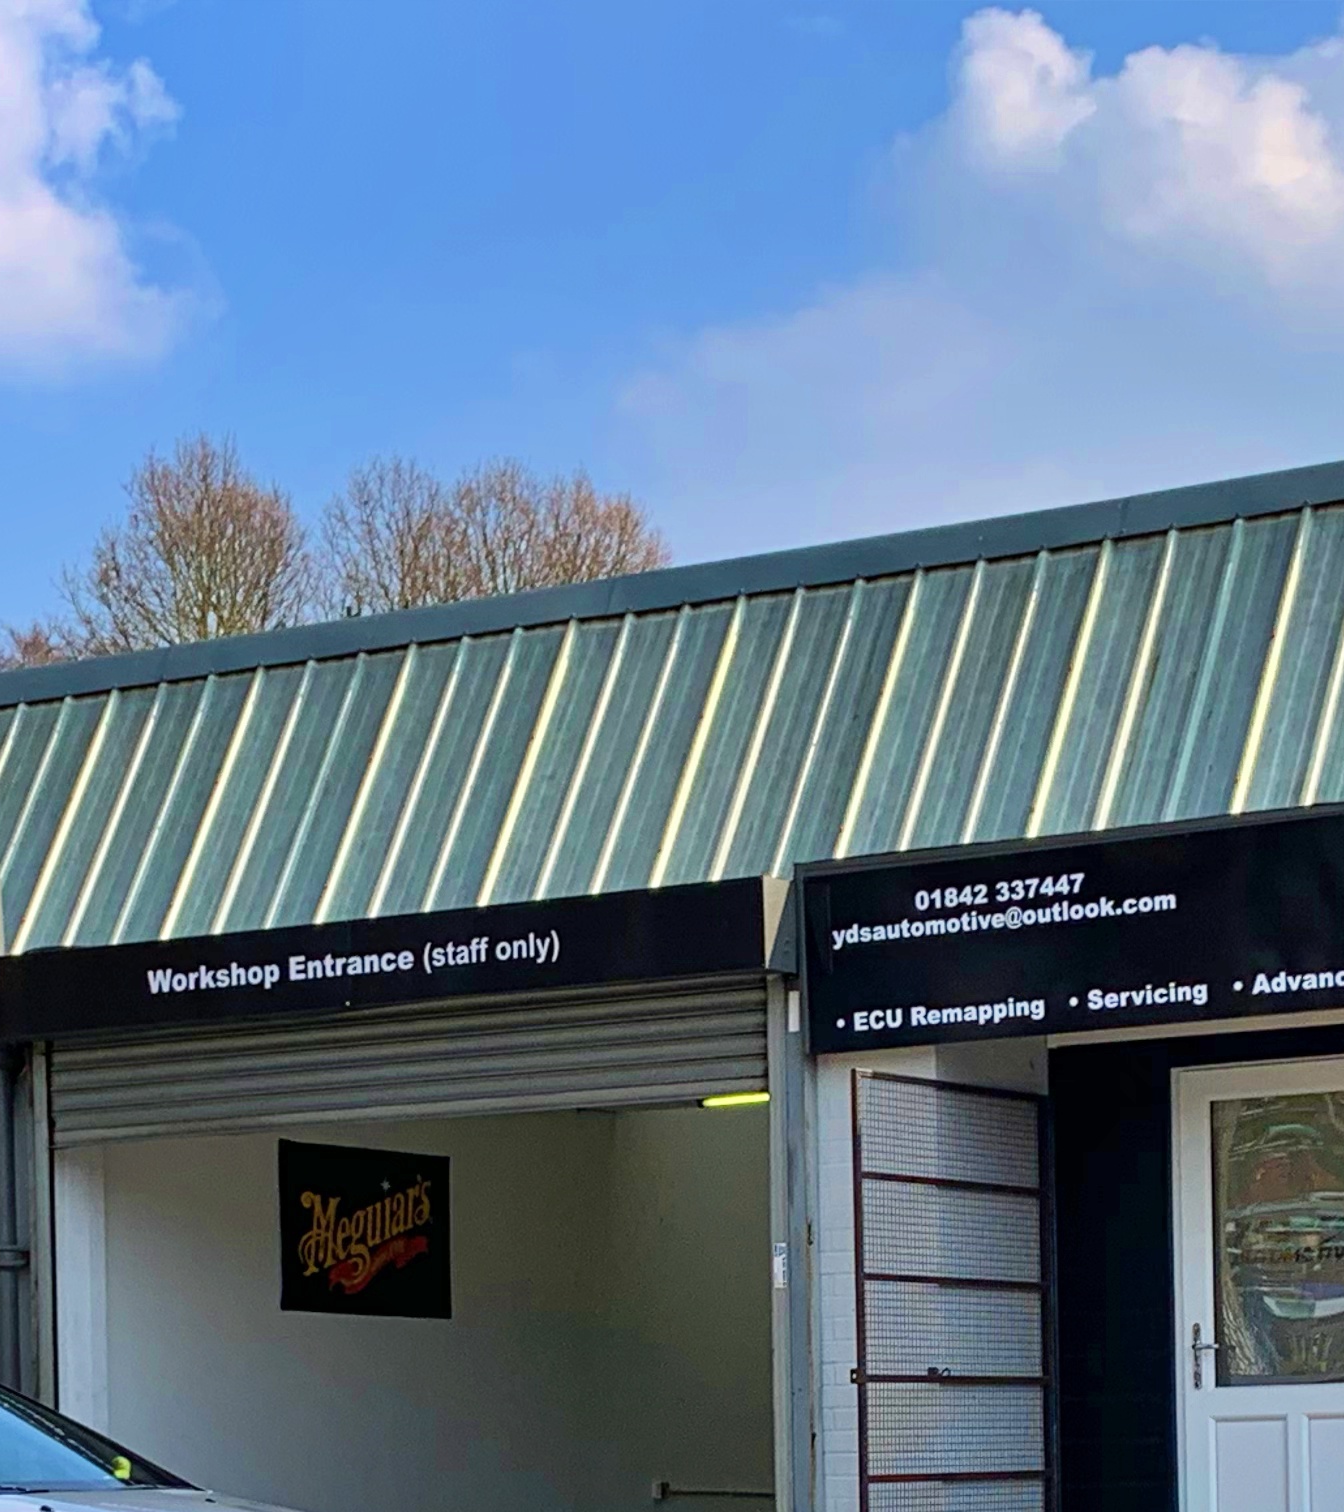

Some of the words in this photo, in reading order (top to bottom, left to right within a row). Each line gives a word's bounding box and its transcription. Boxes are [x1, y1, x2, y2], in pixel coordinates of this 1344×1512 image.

[831, 890, 1177, 951] ydsautomotive@outlook.com
[914, 883, 989, 911] 01842
[995, 872, 1086, 901] 337447
[147, 961, 280, 995] Workshop
[288, 949, 415, 981] Entrance
[423, 936, 489, 974] (staff
[495, 929, 560, 964] only)
[853, 1007, 903, 1032] ECU
[910, 997, 1046, 1027] Remapping
[1087, 981, 1208, 1010] Servicing
[298, 1174, 431, 1286] Meguiar's
